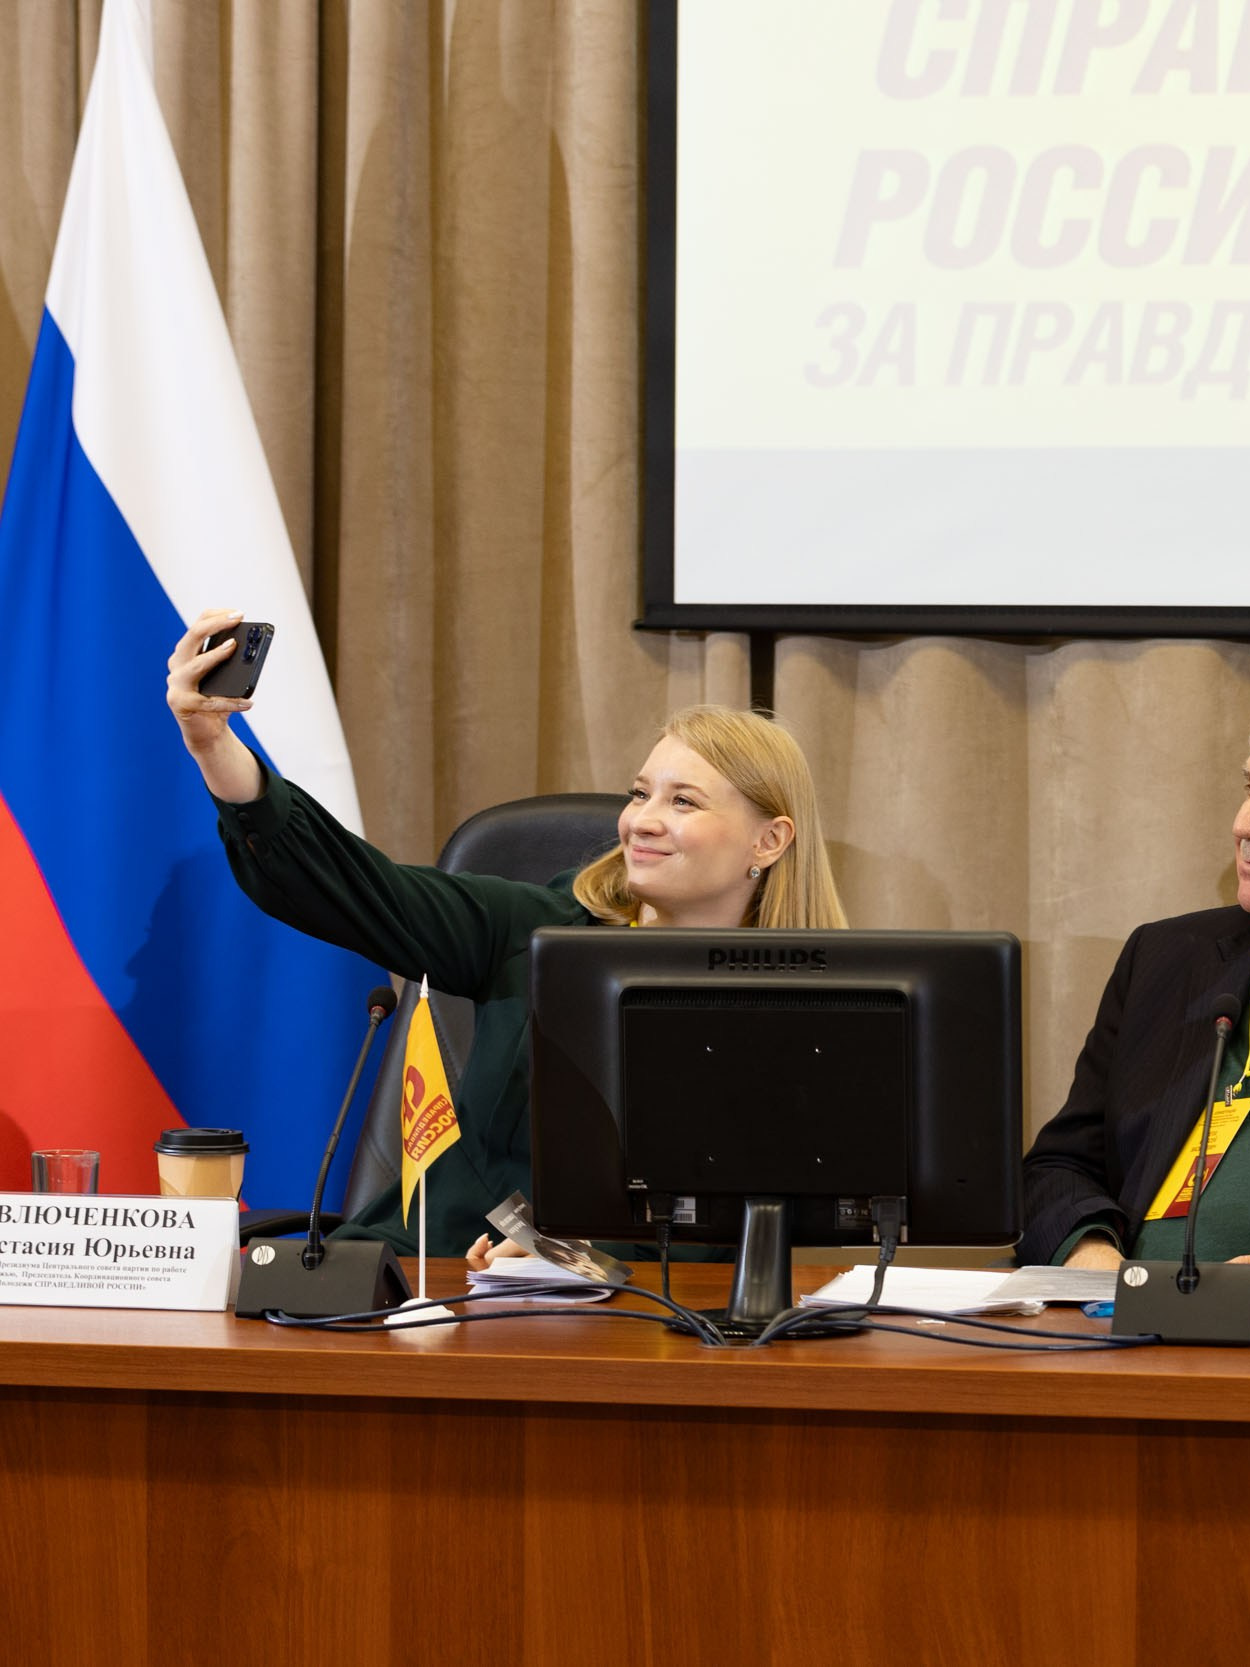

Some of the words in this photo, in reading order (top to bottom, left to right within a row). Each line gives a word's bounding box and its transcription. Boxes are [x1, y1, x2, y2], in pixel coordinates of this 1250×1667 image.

[803, 300, 918, 390] ЗА
[707, 949, 828, 972] PHILIPS
[0, 1204, 196, 1229] ВЛЮЧЕНКОВА
[84, 1237, 196, 1263] Юрьевна
